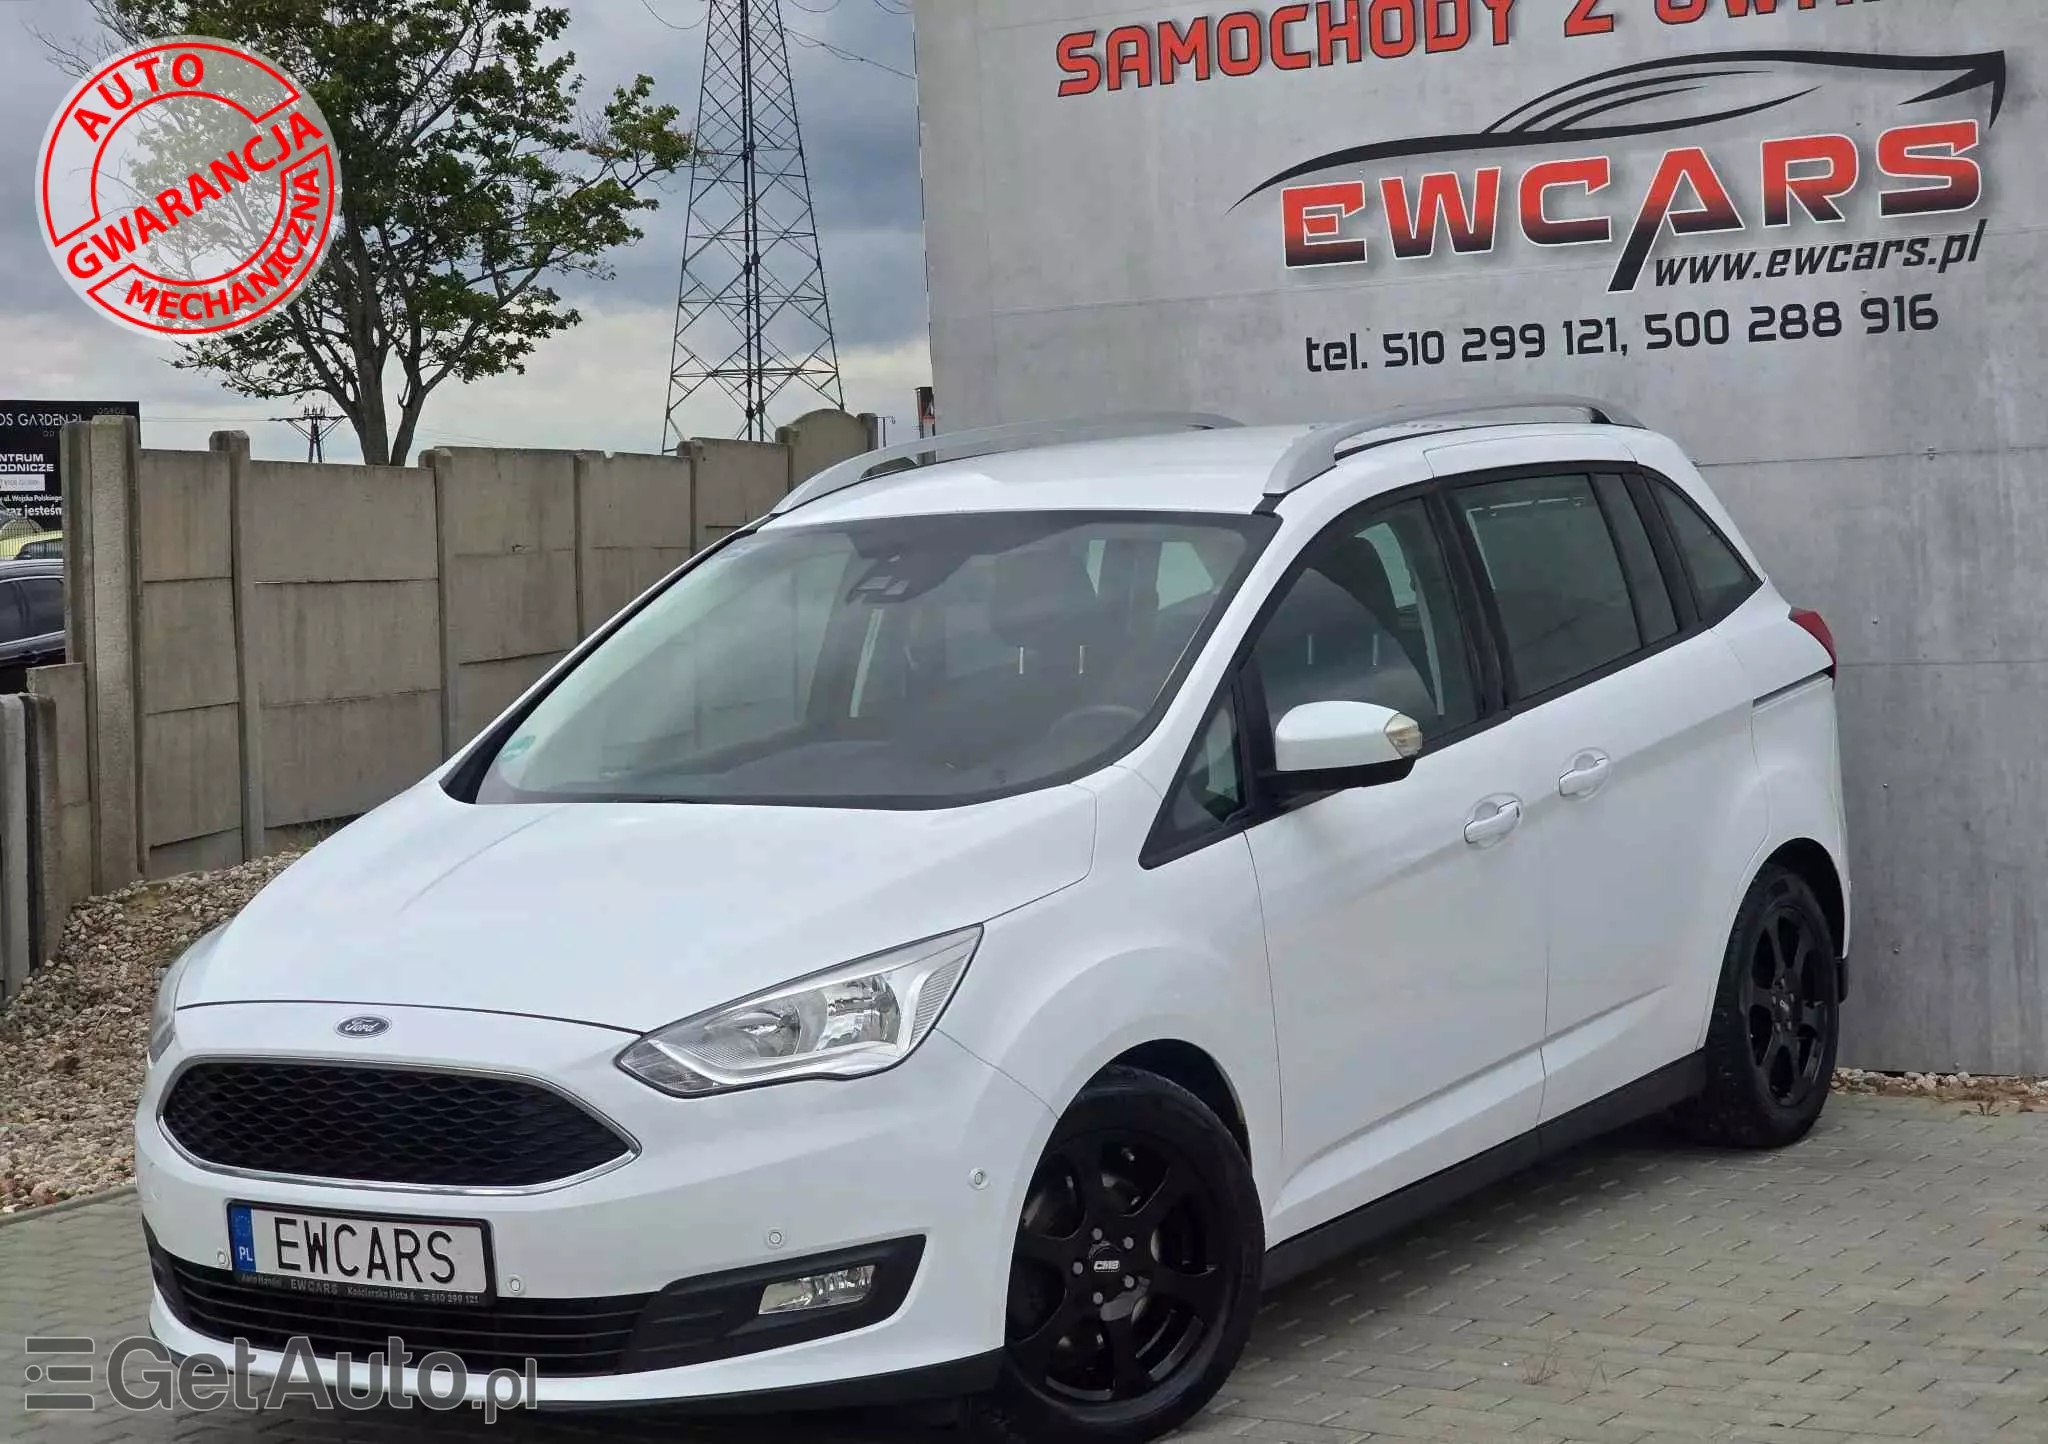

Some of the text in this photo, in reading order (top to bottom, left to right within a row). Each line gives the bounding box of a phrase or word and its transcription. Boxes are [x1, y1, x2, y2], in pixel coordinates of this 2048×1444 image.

[1056, 0, 1517, 97] SAMOCHODY
[1281, 119, 1982, 293] EWCARS
[1655, 218, 1988, 287] www.ewcars.pl
[1306, 293, 1939, 373] tel. 510 299 121, 500 288 916
[18, 413, 83, 426] GARDENPL
[345, 1019, 380, 1032] Ford
[239, 1246, 253, 1262] PL
[274, 1216, 456, 1284] EWCARS
